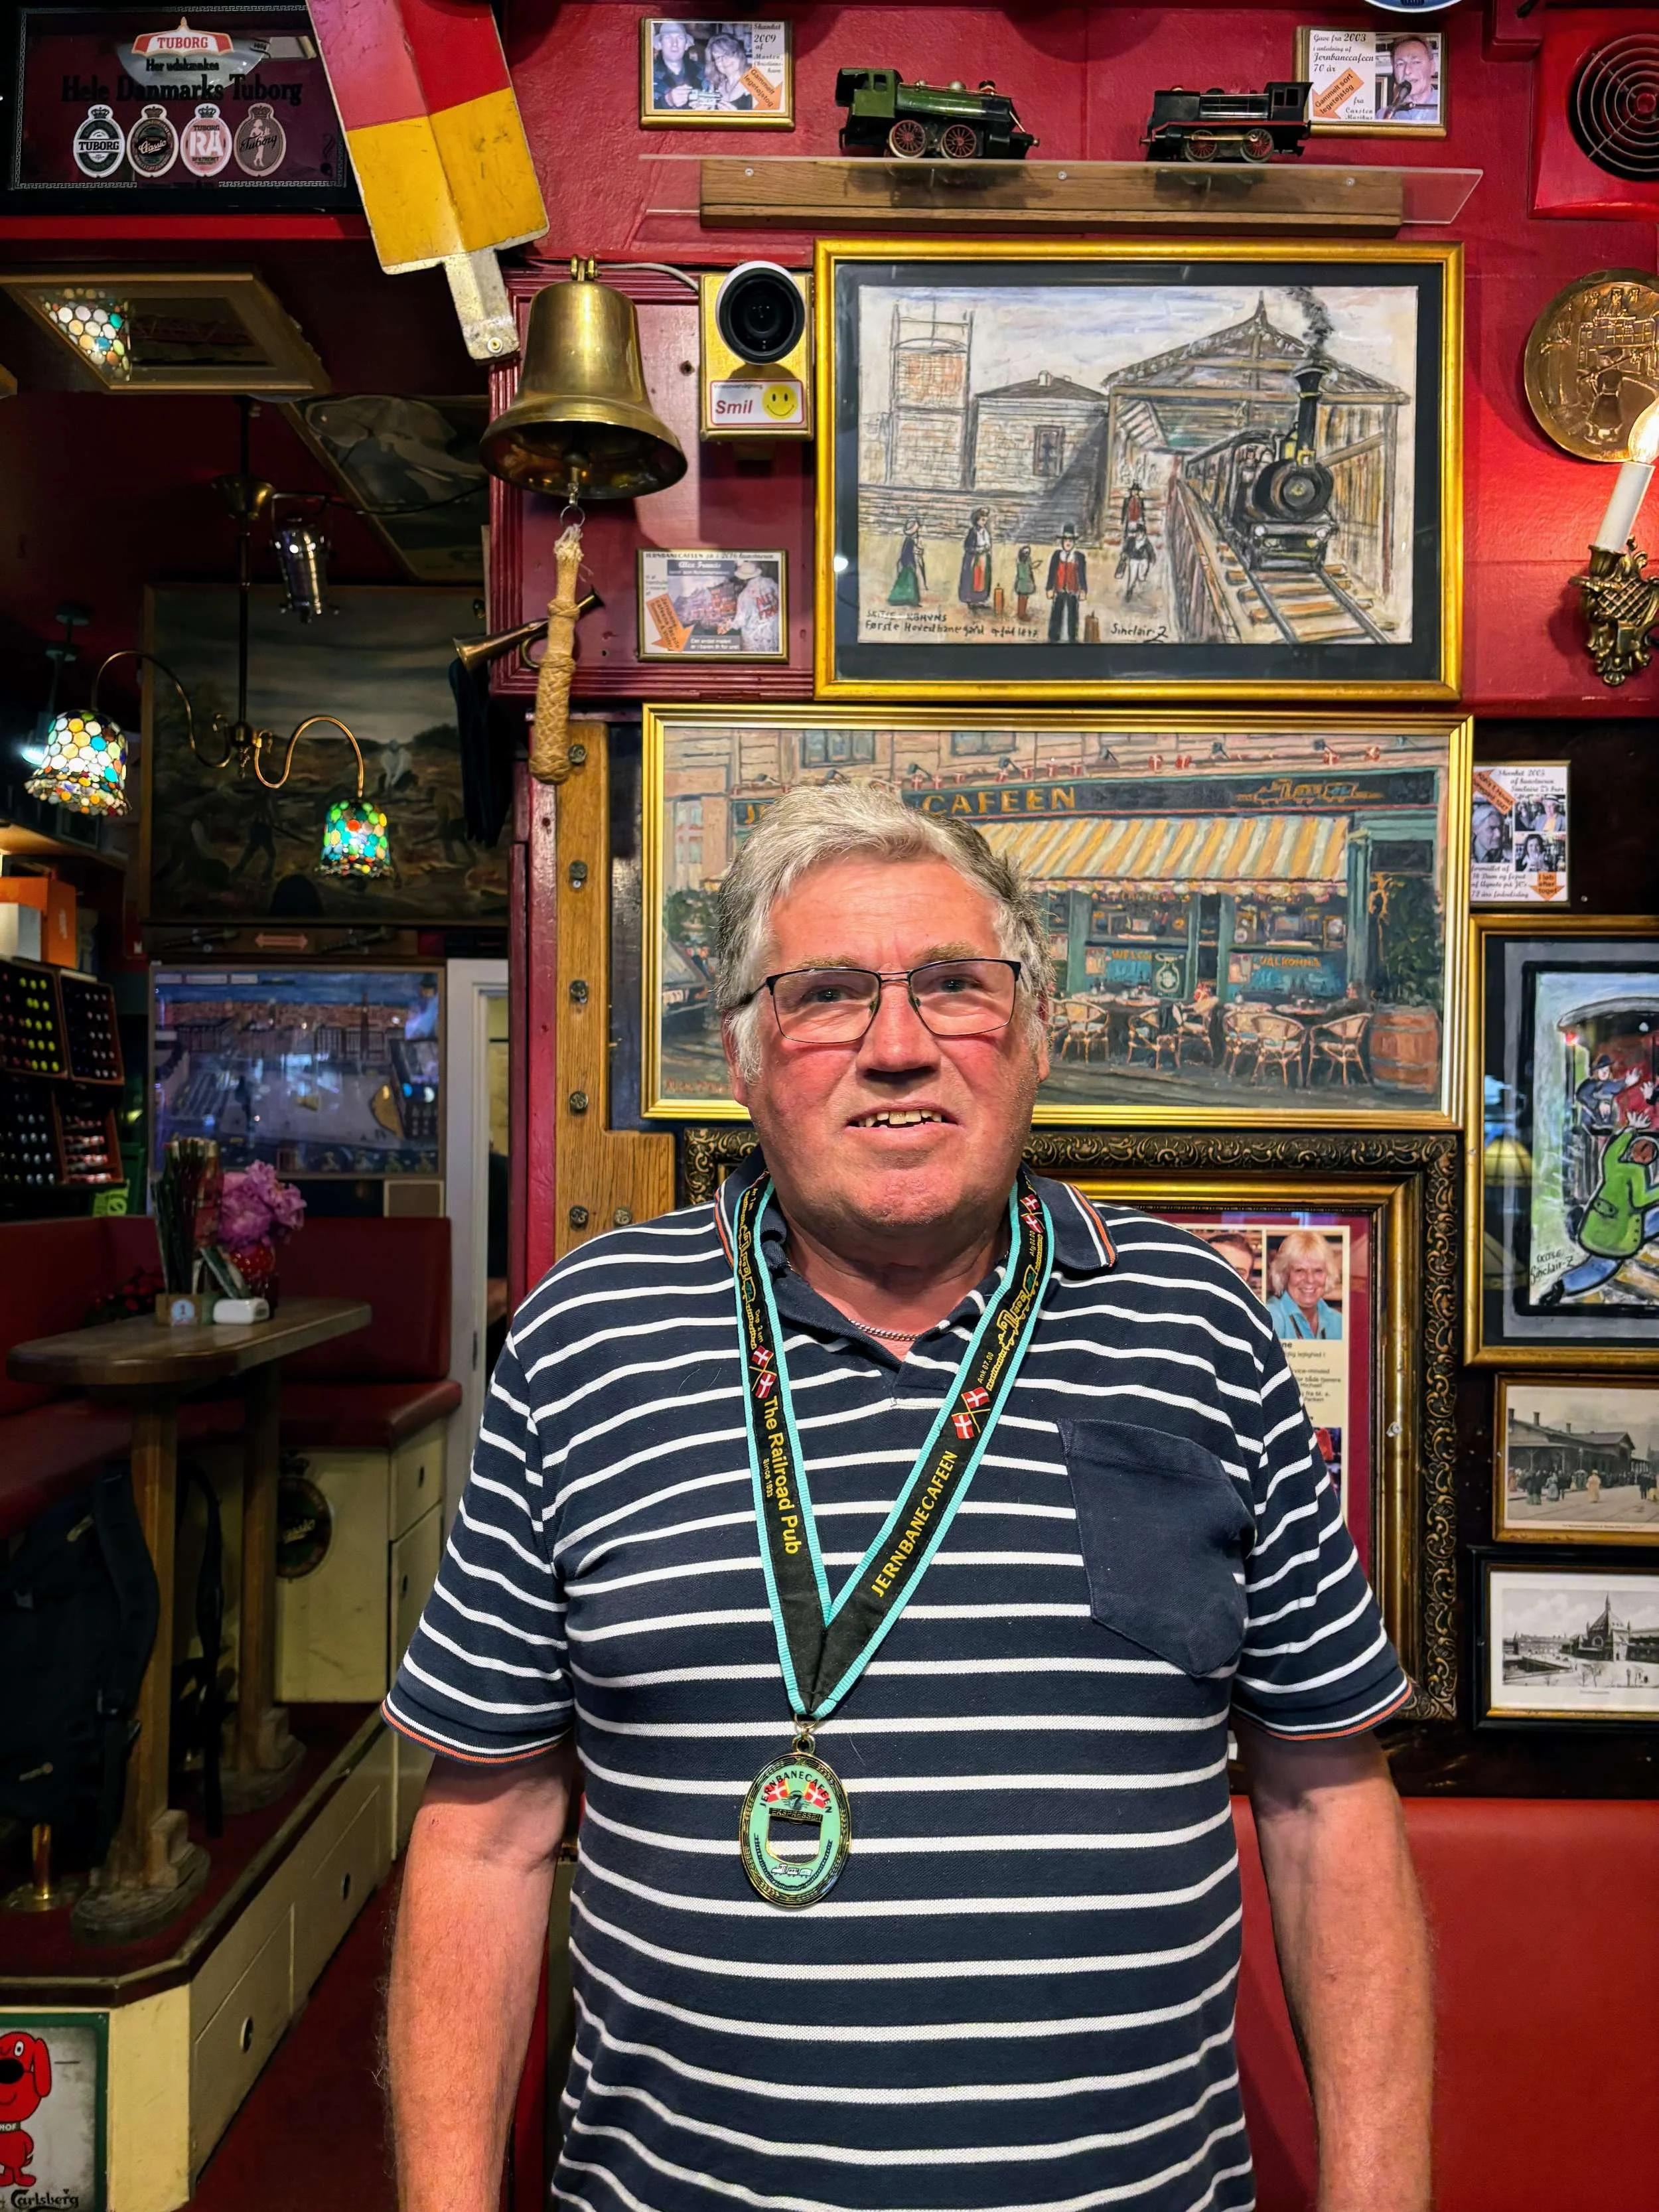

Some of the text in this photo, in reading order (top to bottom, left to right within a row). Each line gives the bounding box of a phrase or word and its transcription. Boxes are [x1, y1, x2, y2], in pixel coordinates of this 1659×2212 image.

[157, 37, 208, 49] TUBORG
[754, 35, 776, 43] 2009
[1344, 33, 1366, 42] 2003
[755, 43, 763, 52] af
[1313, 52, 1374, 64] Jernbanecafeen
[1314, 63, 1325, 72] 70
[751, 68, 775, 95] Gammelt
[62, 74, 303, 106] Hele Danmarks Tuborg
[1315, 73, 1354, 108] Gammelt sort
[1319, 84, 1355, 114] legetøjstog
[1353, 96, 1364, 106] fra
[78, 141, 119, 151] TUBORG
[138, 139, 167, 154] Classic
[715, 400, 753, 414] Smil
[865, 621, 900, 631] Første
[922, 786, 1076, 820] CAFEEN
[977, 1351, 994, 1384] Ank 07.00
[764, 1395, 802, 1555] The Railroad Pub
[871, 1449, 959, 1598] JERNBANECAFEEN
[759, 1770, 833, 1814] JERNBANECAFEEN
[771, 1810, 822, 1822] EKSPRESSEN
[11, 2189, 80, 2210] Carlsberg
